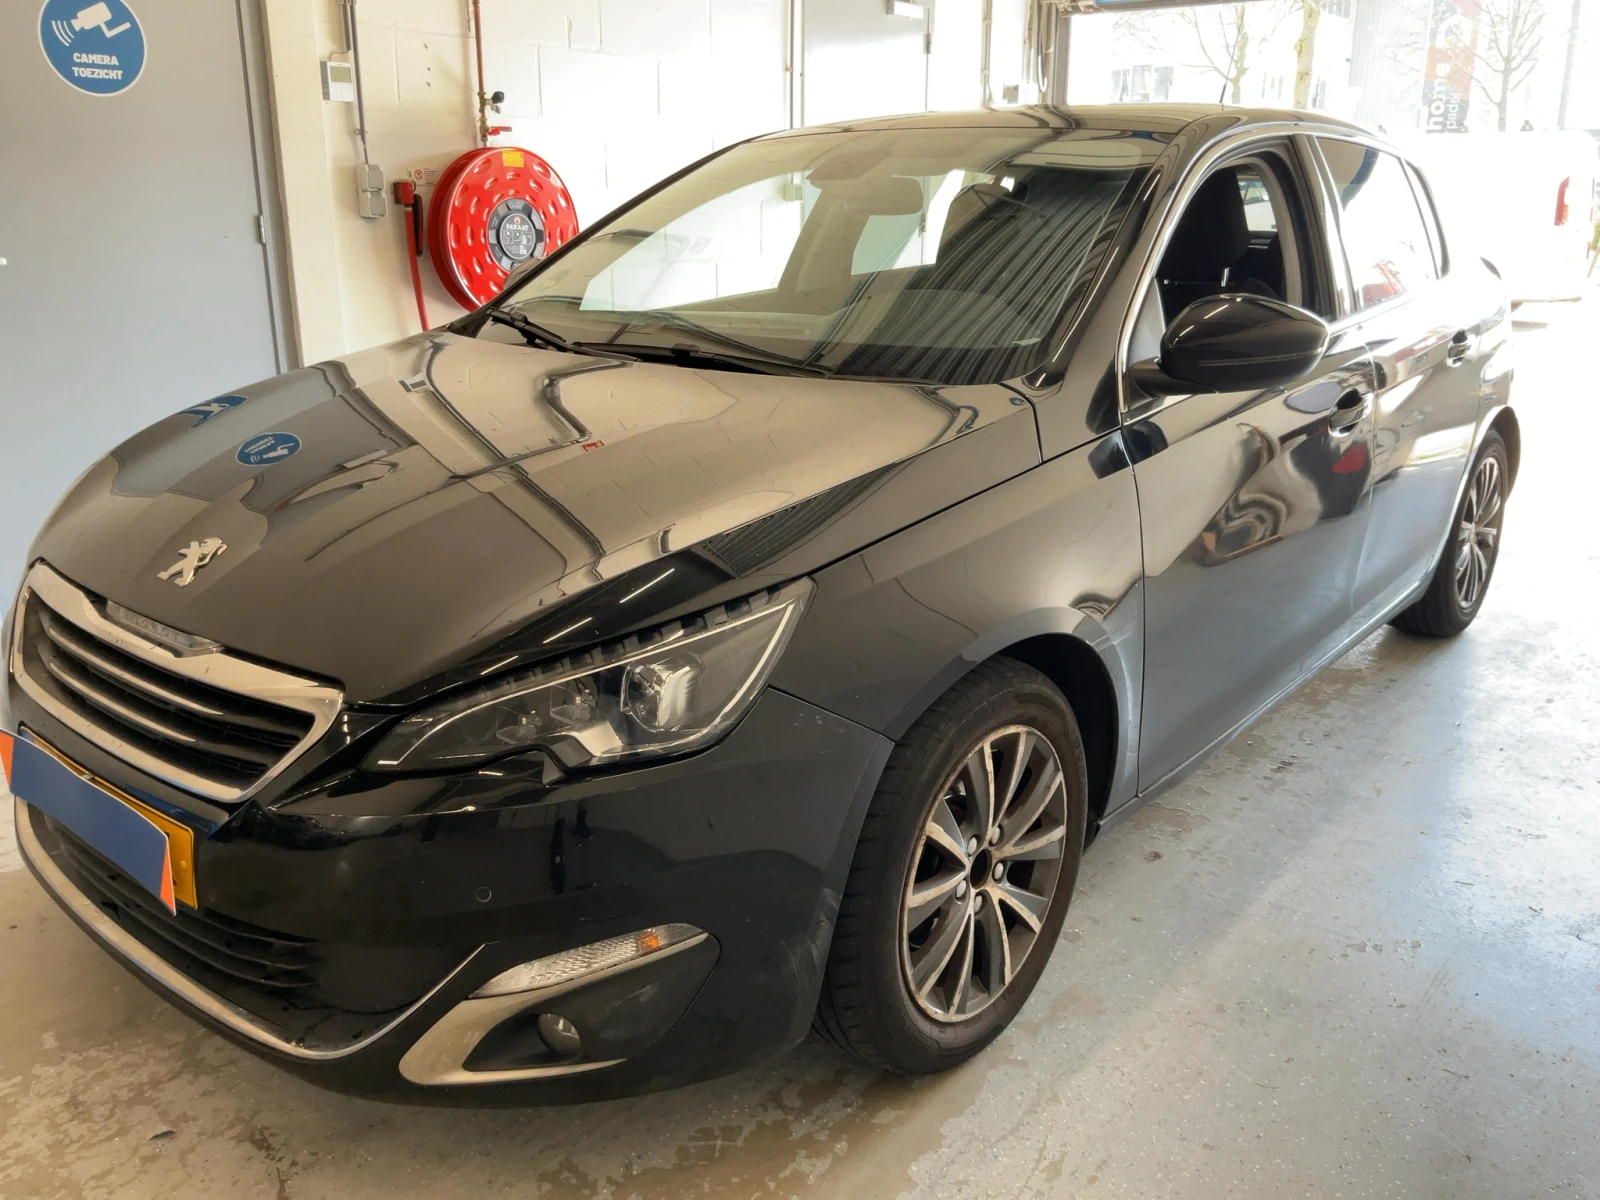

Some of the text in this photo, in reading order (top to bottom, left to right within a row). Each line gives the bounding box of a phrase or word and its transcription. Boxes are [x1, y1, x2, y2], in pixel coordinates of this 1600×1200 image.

[73, 52, 119, 66] CAMERA
[71, 66, 123, 80] TOEZICHT
[1425, 62, 1450, 131] home
[505, 223, 529, 231] PARAAT
